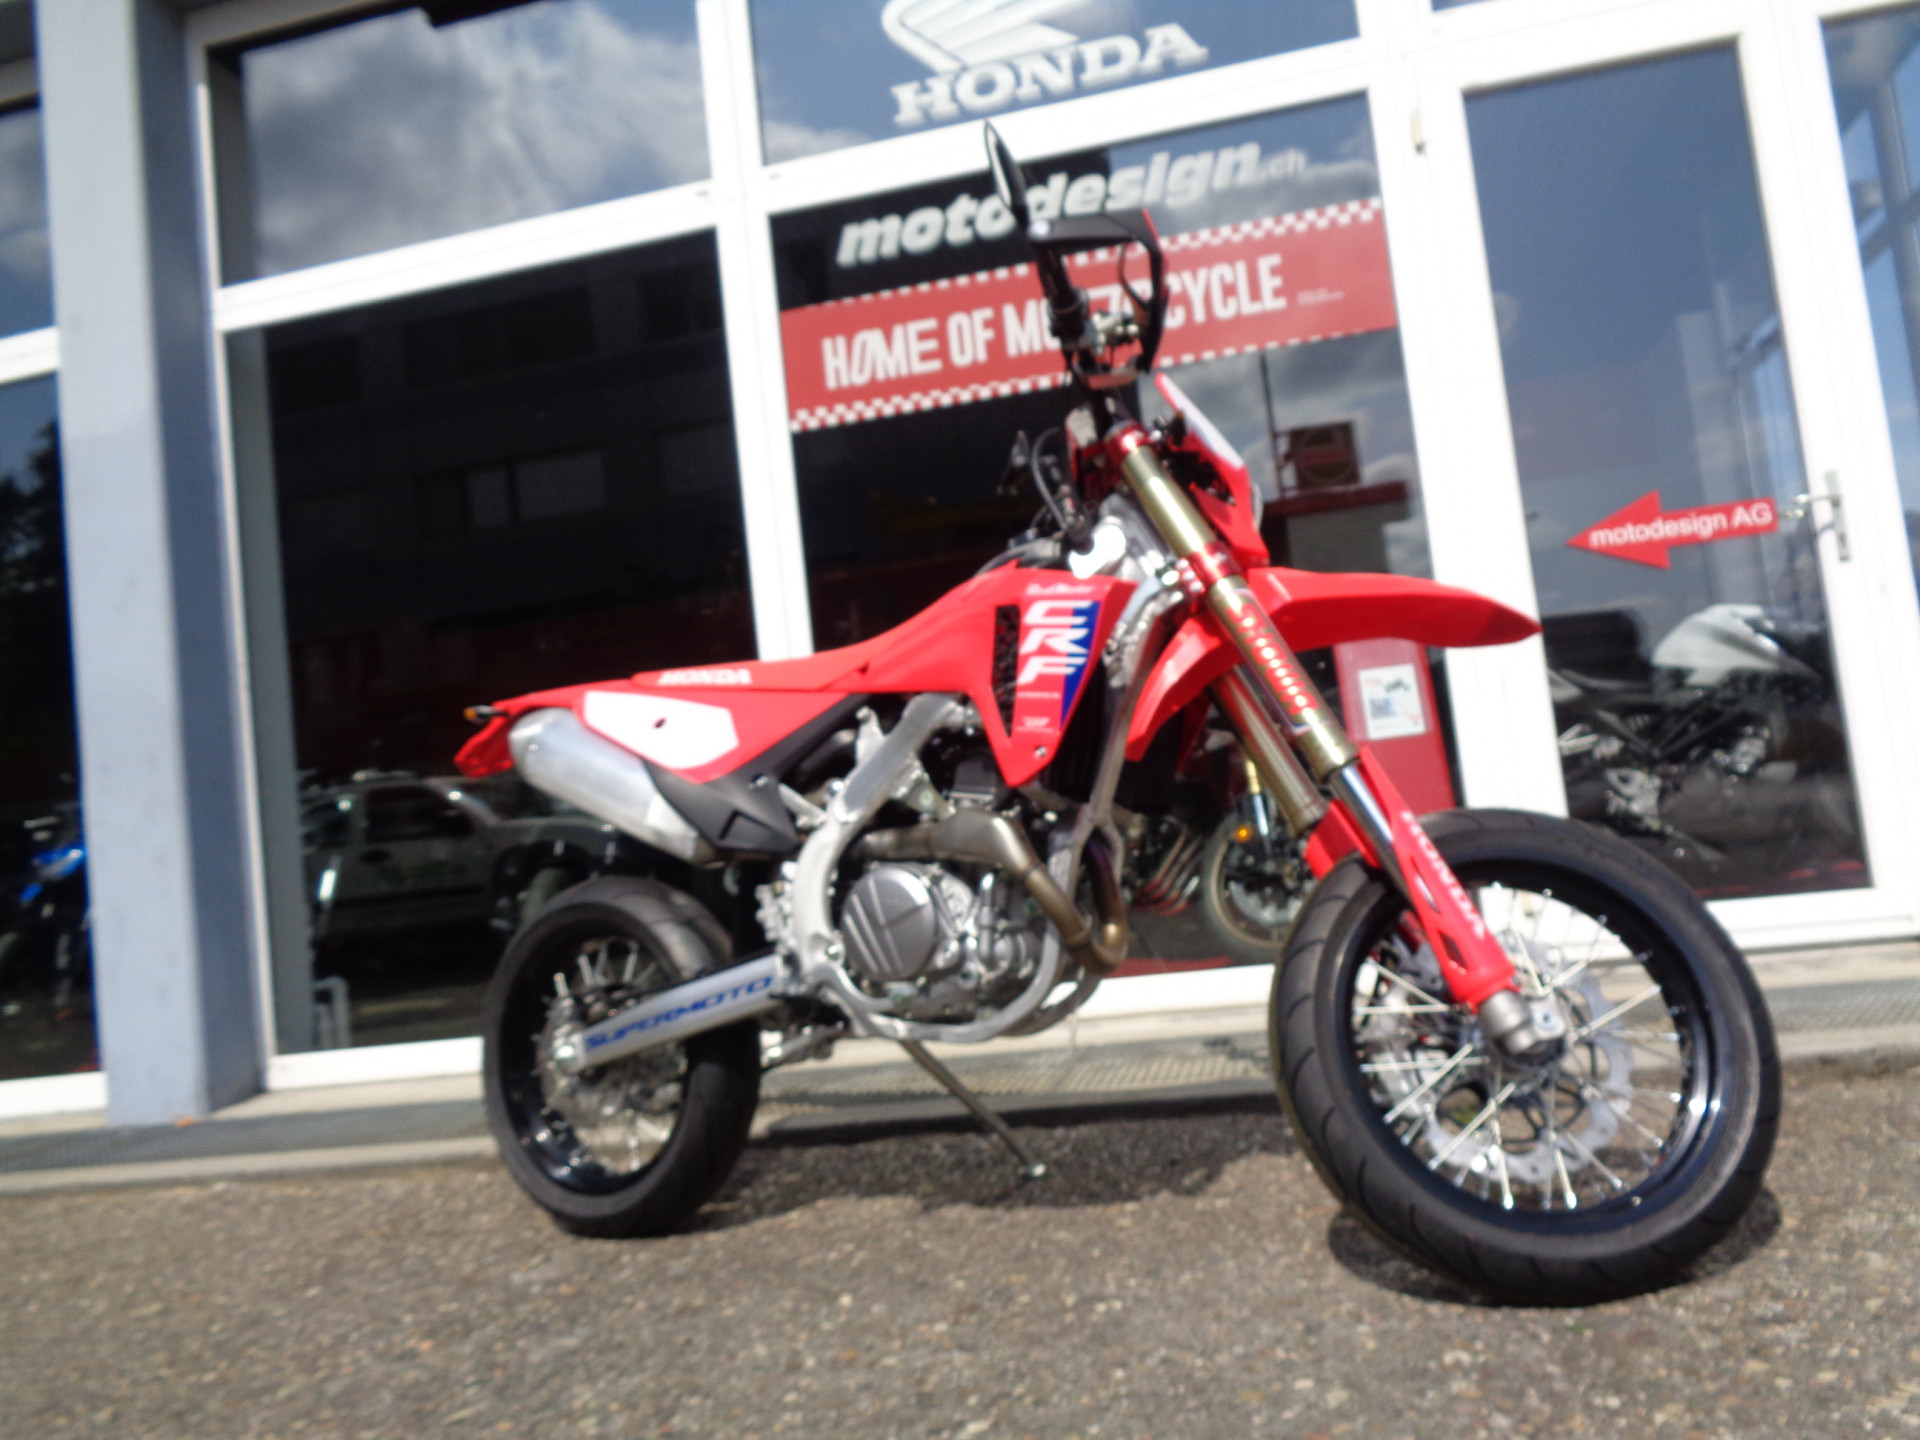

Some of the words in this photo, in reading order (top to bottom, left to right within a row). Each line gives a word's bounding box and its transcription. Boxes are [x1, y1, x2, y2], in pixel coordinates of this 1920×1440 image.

[890, 22, 1209, 124] HONDA
[947, 306, 995, 368] OF
[1589, 512, 1728, 548] motodesign
[1731, 501, 1774, 528] AG
[1018, 600, 1090, 685] CRF
[1226, 603, 1320, 716] SHOWA
[1402, 810, 1488, 941] HONDA
[585, 976, 774, 1049] SUPERMOTO
